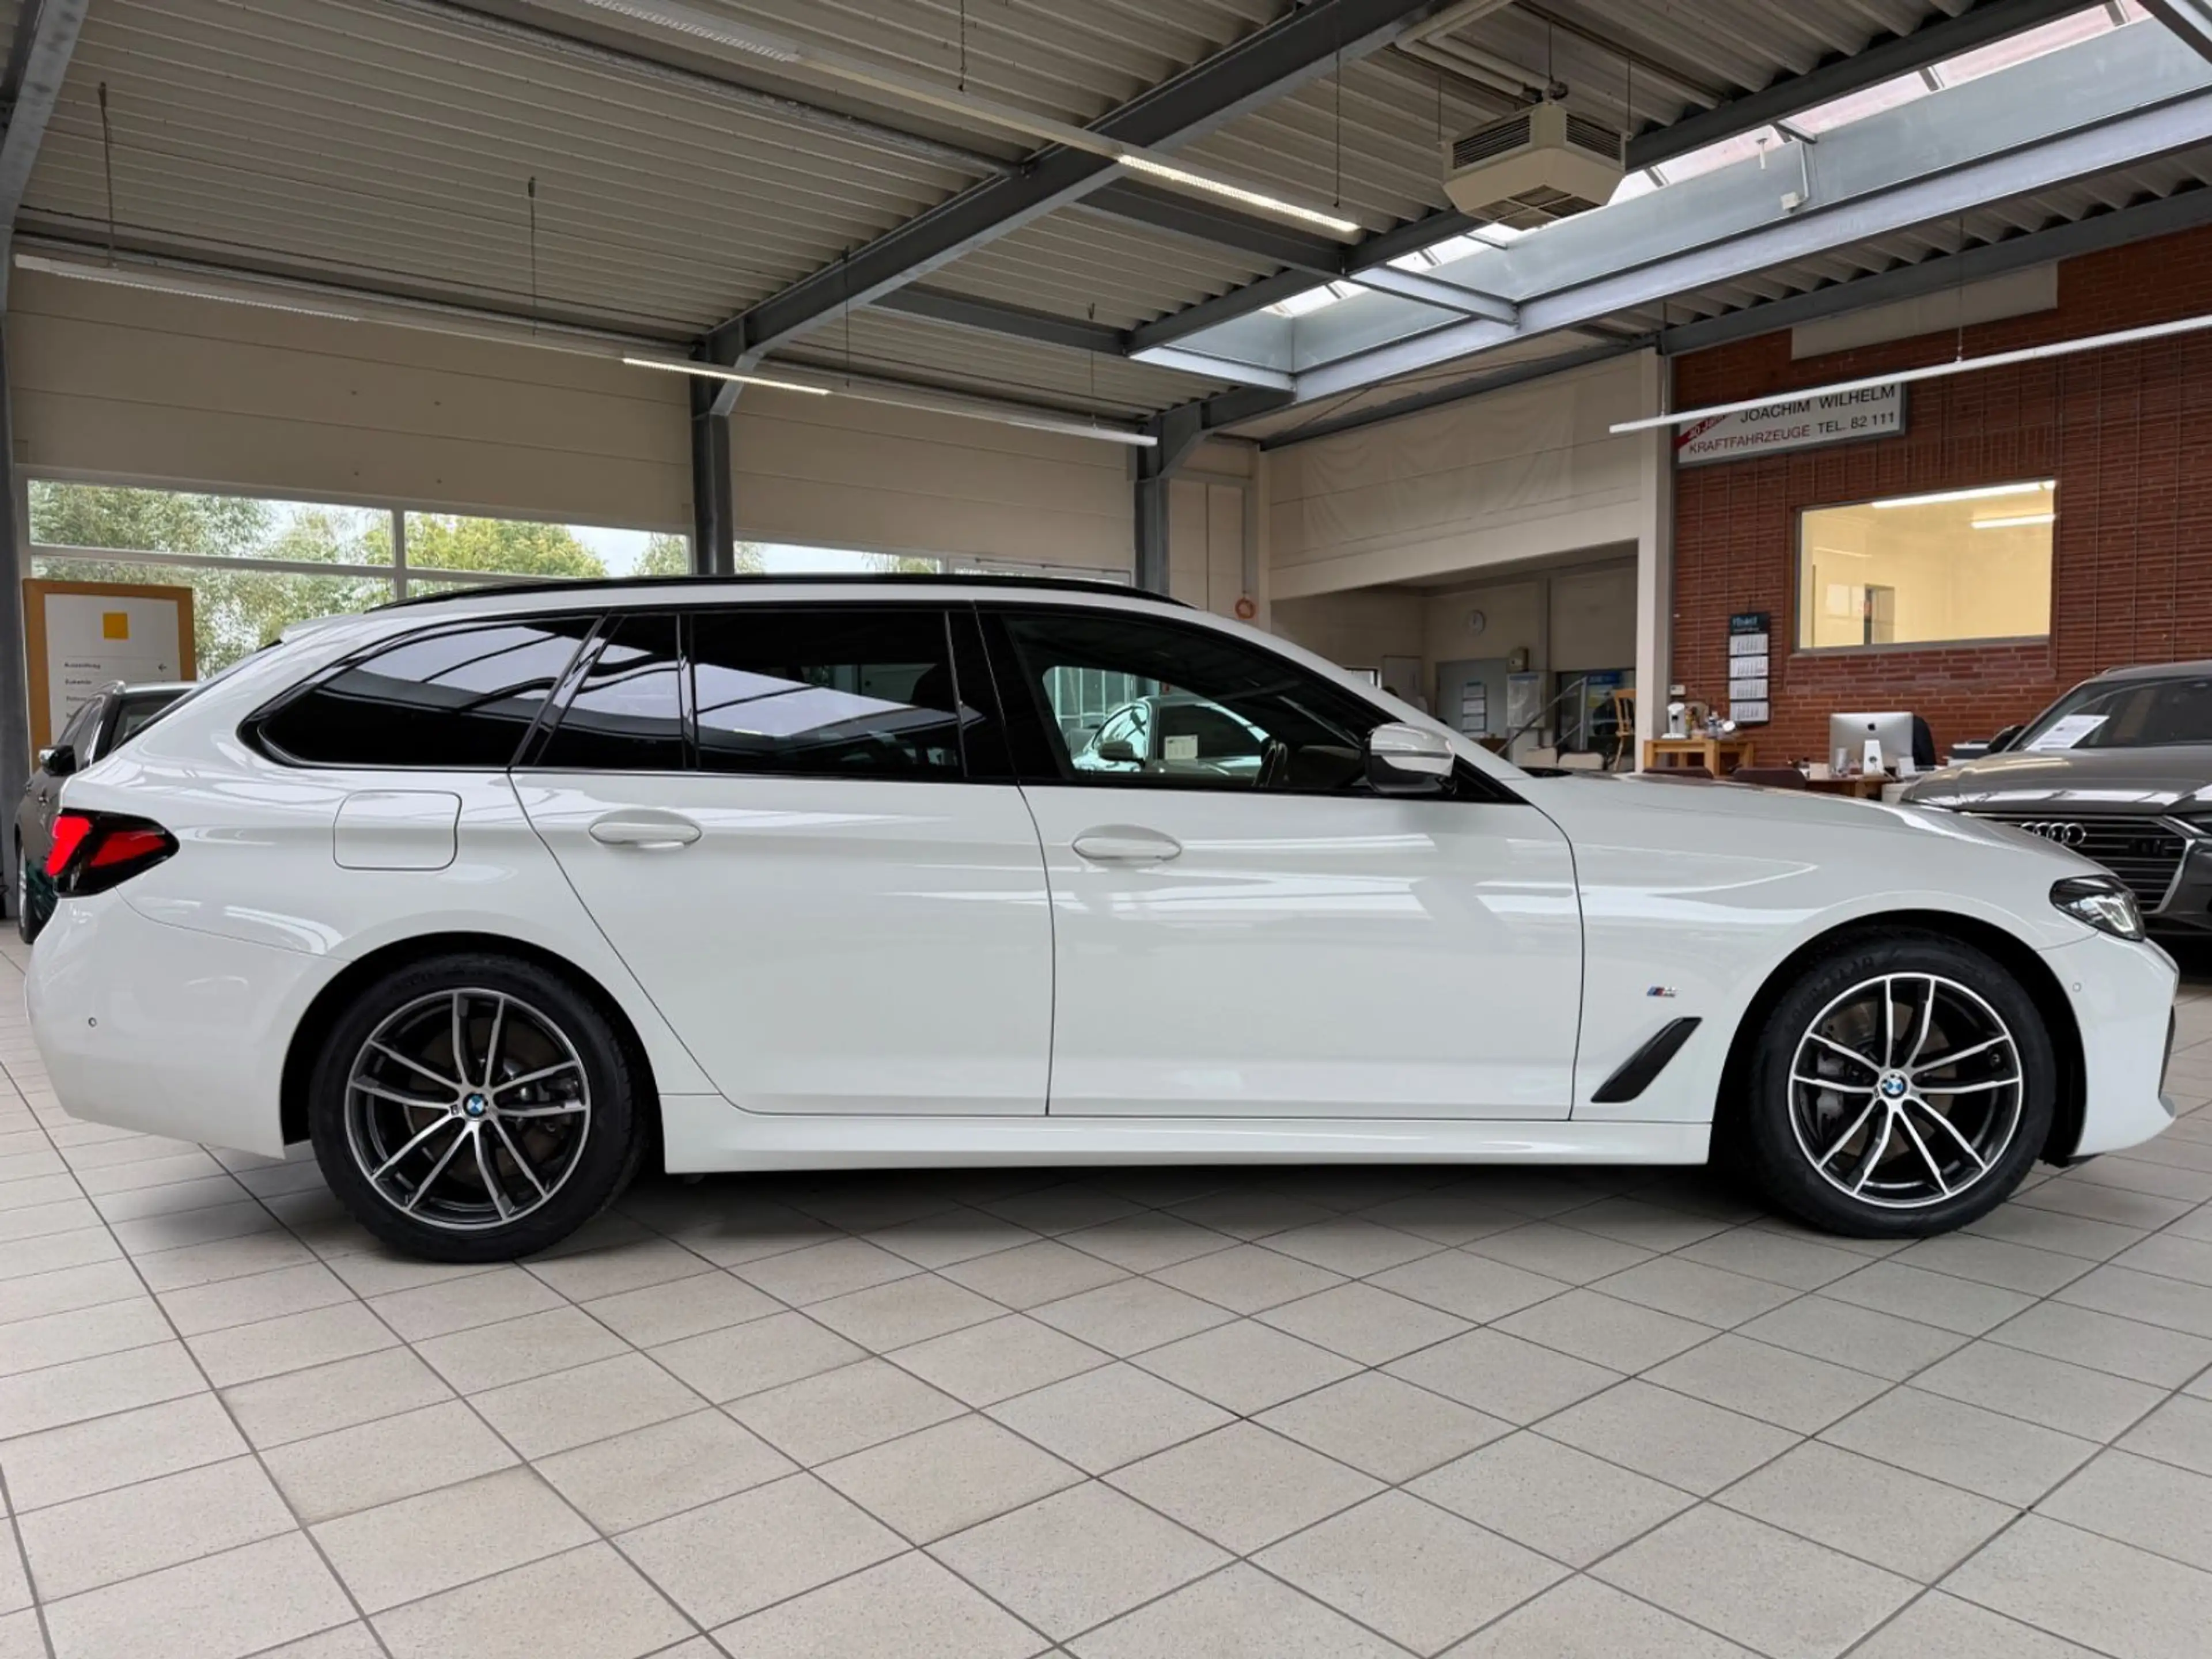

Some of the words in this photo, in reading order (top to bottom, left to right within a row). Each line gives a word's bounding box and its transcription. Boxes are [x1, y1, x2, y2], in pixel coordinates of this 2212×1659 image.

[1740, 399, 1810, 423] JOACHIM
[1819, 384, 1895, 409] WILHELM
[1688, 424, 1810, 454] KRAFTFAHRZEUGE
[1872, 411, 1894, 426] 111
